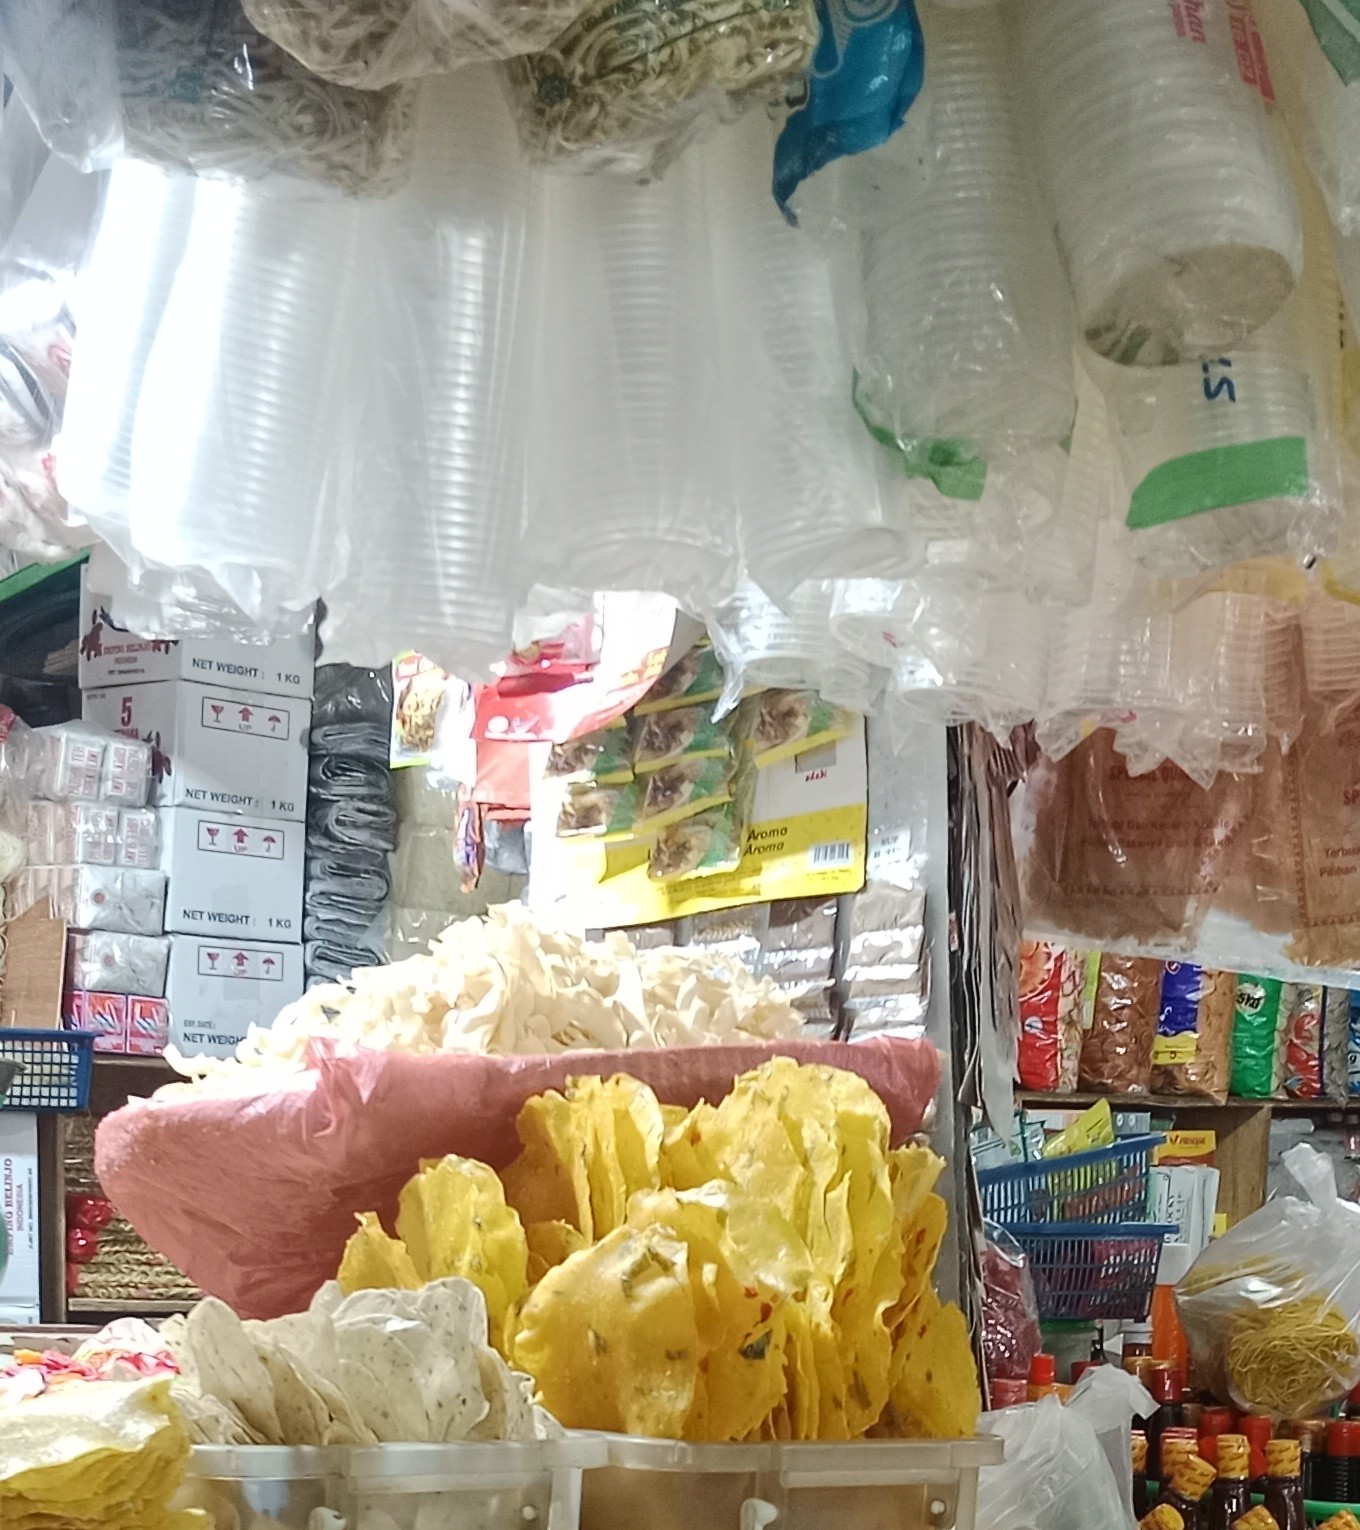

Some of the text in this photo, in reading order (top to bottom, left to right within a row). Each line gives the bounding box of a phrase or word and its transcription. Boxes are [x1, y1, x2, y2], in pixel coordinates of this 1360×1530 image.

[192, 657, 214, 670] NET
[216, 661, 259, 678] WEIGHT
[284, 674, 301, 685] KG
[185, 788, 207, 801] NET
[211, 790, 253, 807] WEIGHT
[278, 801, 295, 811] KG
[747, 826, 788, 842] Aroma
[743, 841, 785, 857] Aroma
[182, 909, 204, 921] NET
[208, 911, 250, 926] WEIGHT
[276, 918, 292, 930] KG
[183, 1032, 205, 1044] NET
